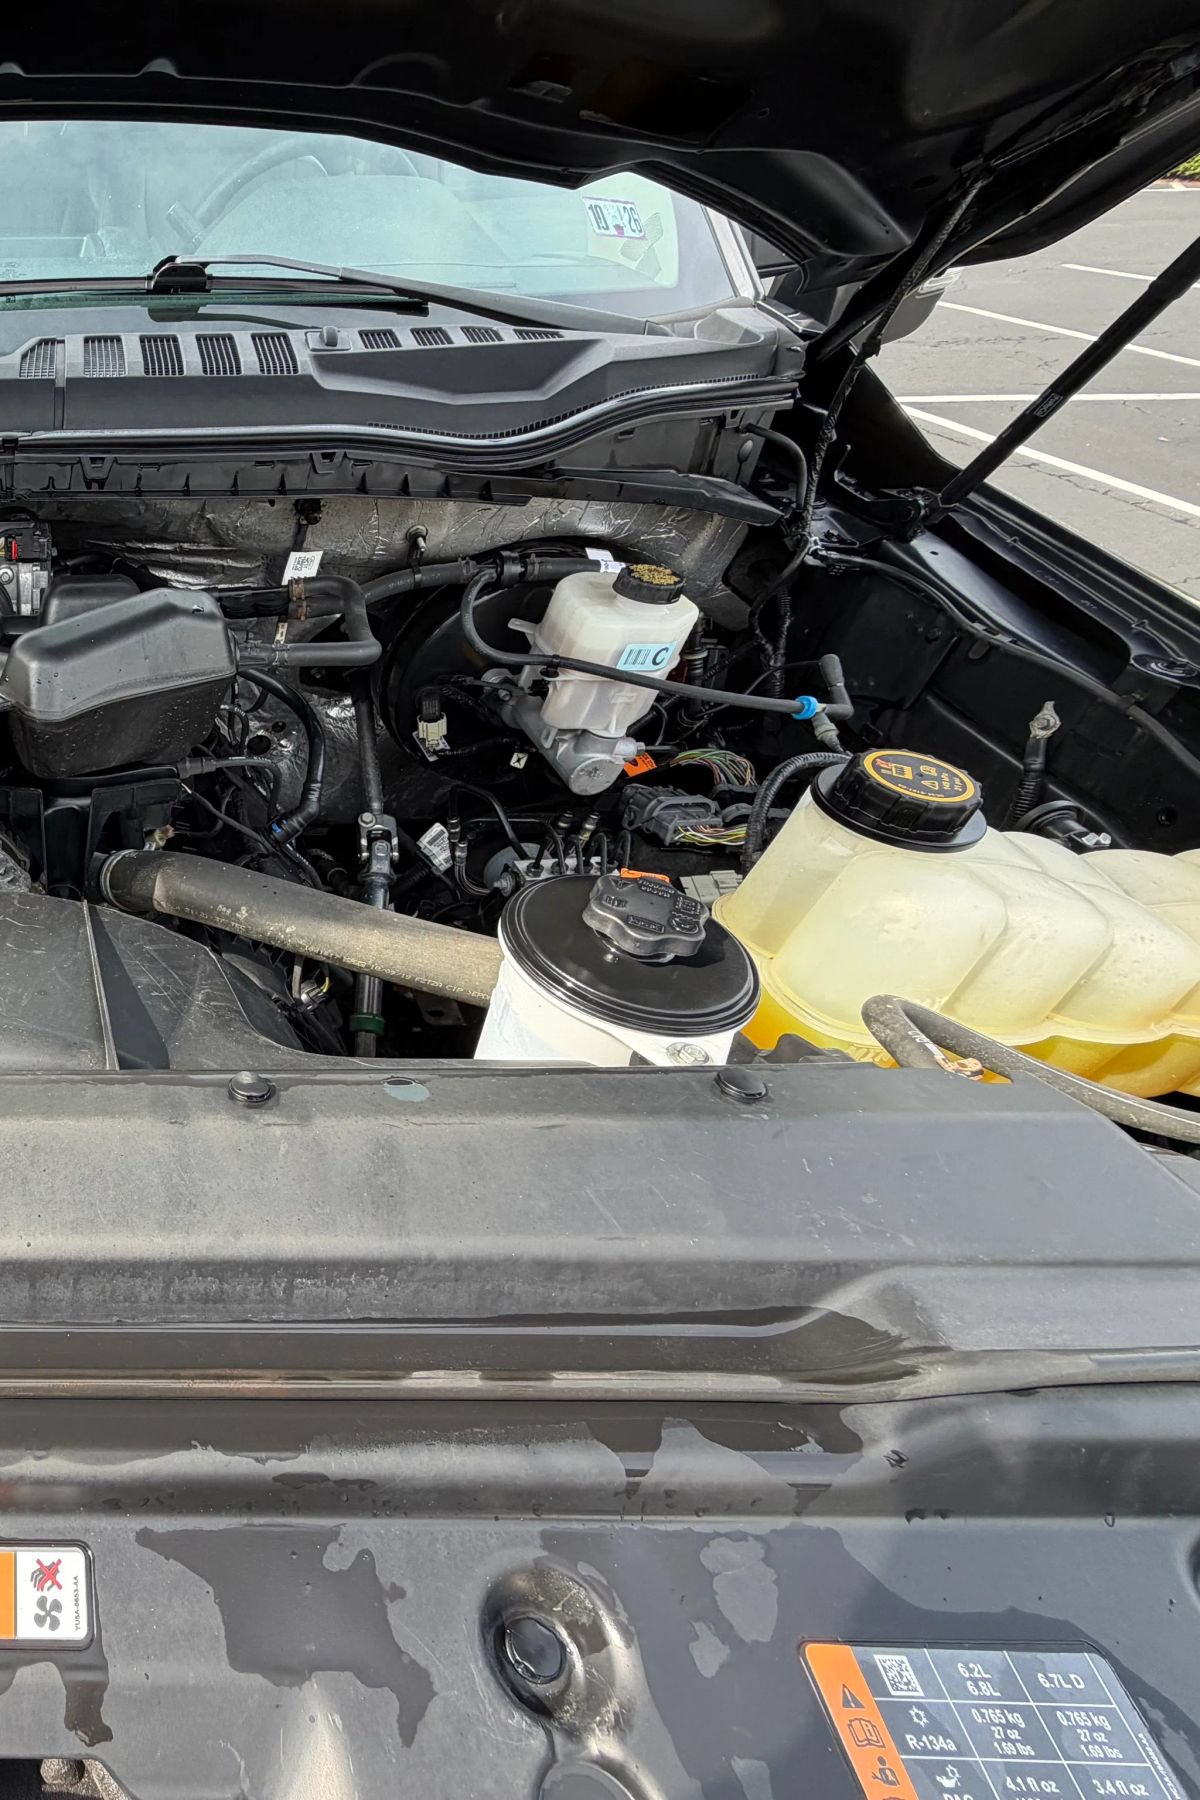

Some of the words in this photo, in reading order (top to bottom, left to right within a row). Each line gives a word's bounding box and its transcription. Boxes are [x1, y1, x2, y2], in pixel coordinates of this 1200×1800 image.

[588, 204, 609, 231] 10
[622, 206, 643, 233] 26
[651, 647, 669, 666] C
[957, 1663, 993, 1679] 6.2L
[966, 1680, 1001, 1697] 6.8L
[1037, 1673, 1072, 1689] 6.7L
[1068, 1673, 1086, 1689] D
[971, 1708, 1006, 1725] 0.765
[1004, 1709, 1026, 1729] kg
[1056, 1710, 1092, 1727] 0.765
[1090, 1711, 1112, 1731] kg
[990, 1726, 1005, 1740] 27
[1006, 1728, 1022, 1740] oz
[1076, 1728, 1091, 1742] 27
[1092, 1731, 1109, 1743] oz
[905, 1734, 957, 1752] R-134a
[993, 1741, 1017, 1756] 1.69
[1016, 1742, 1036, 1756] lbs
[1080, 1744, 1105, 1759] 1.69
[1103, 1744, 1123, 1759] lbs
[1006, 1776, 1027, 1792] 4.1
[1026, 1776, 1040, 1792] fl
[1040, 1780, 1061, 1793] oz
[1092, 1779, 1117, 1795] 3.4
[1115, 1780, 1130, 1795] fl
[1129, 1783, 1150, 1796] oz
